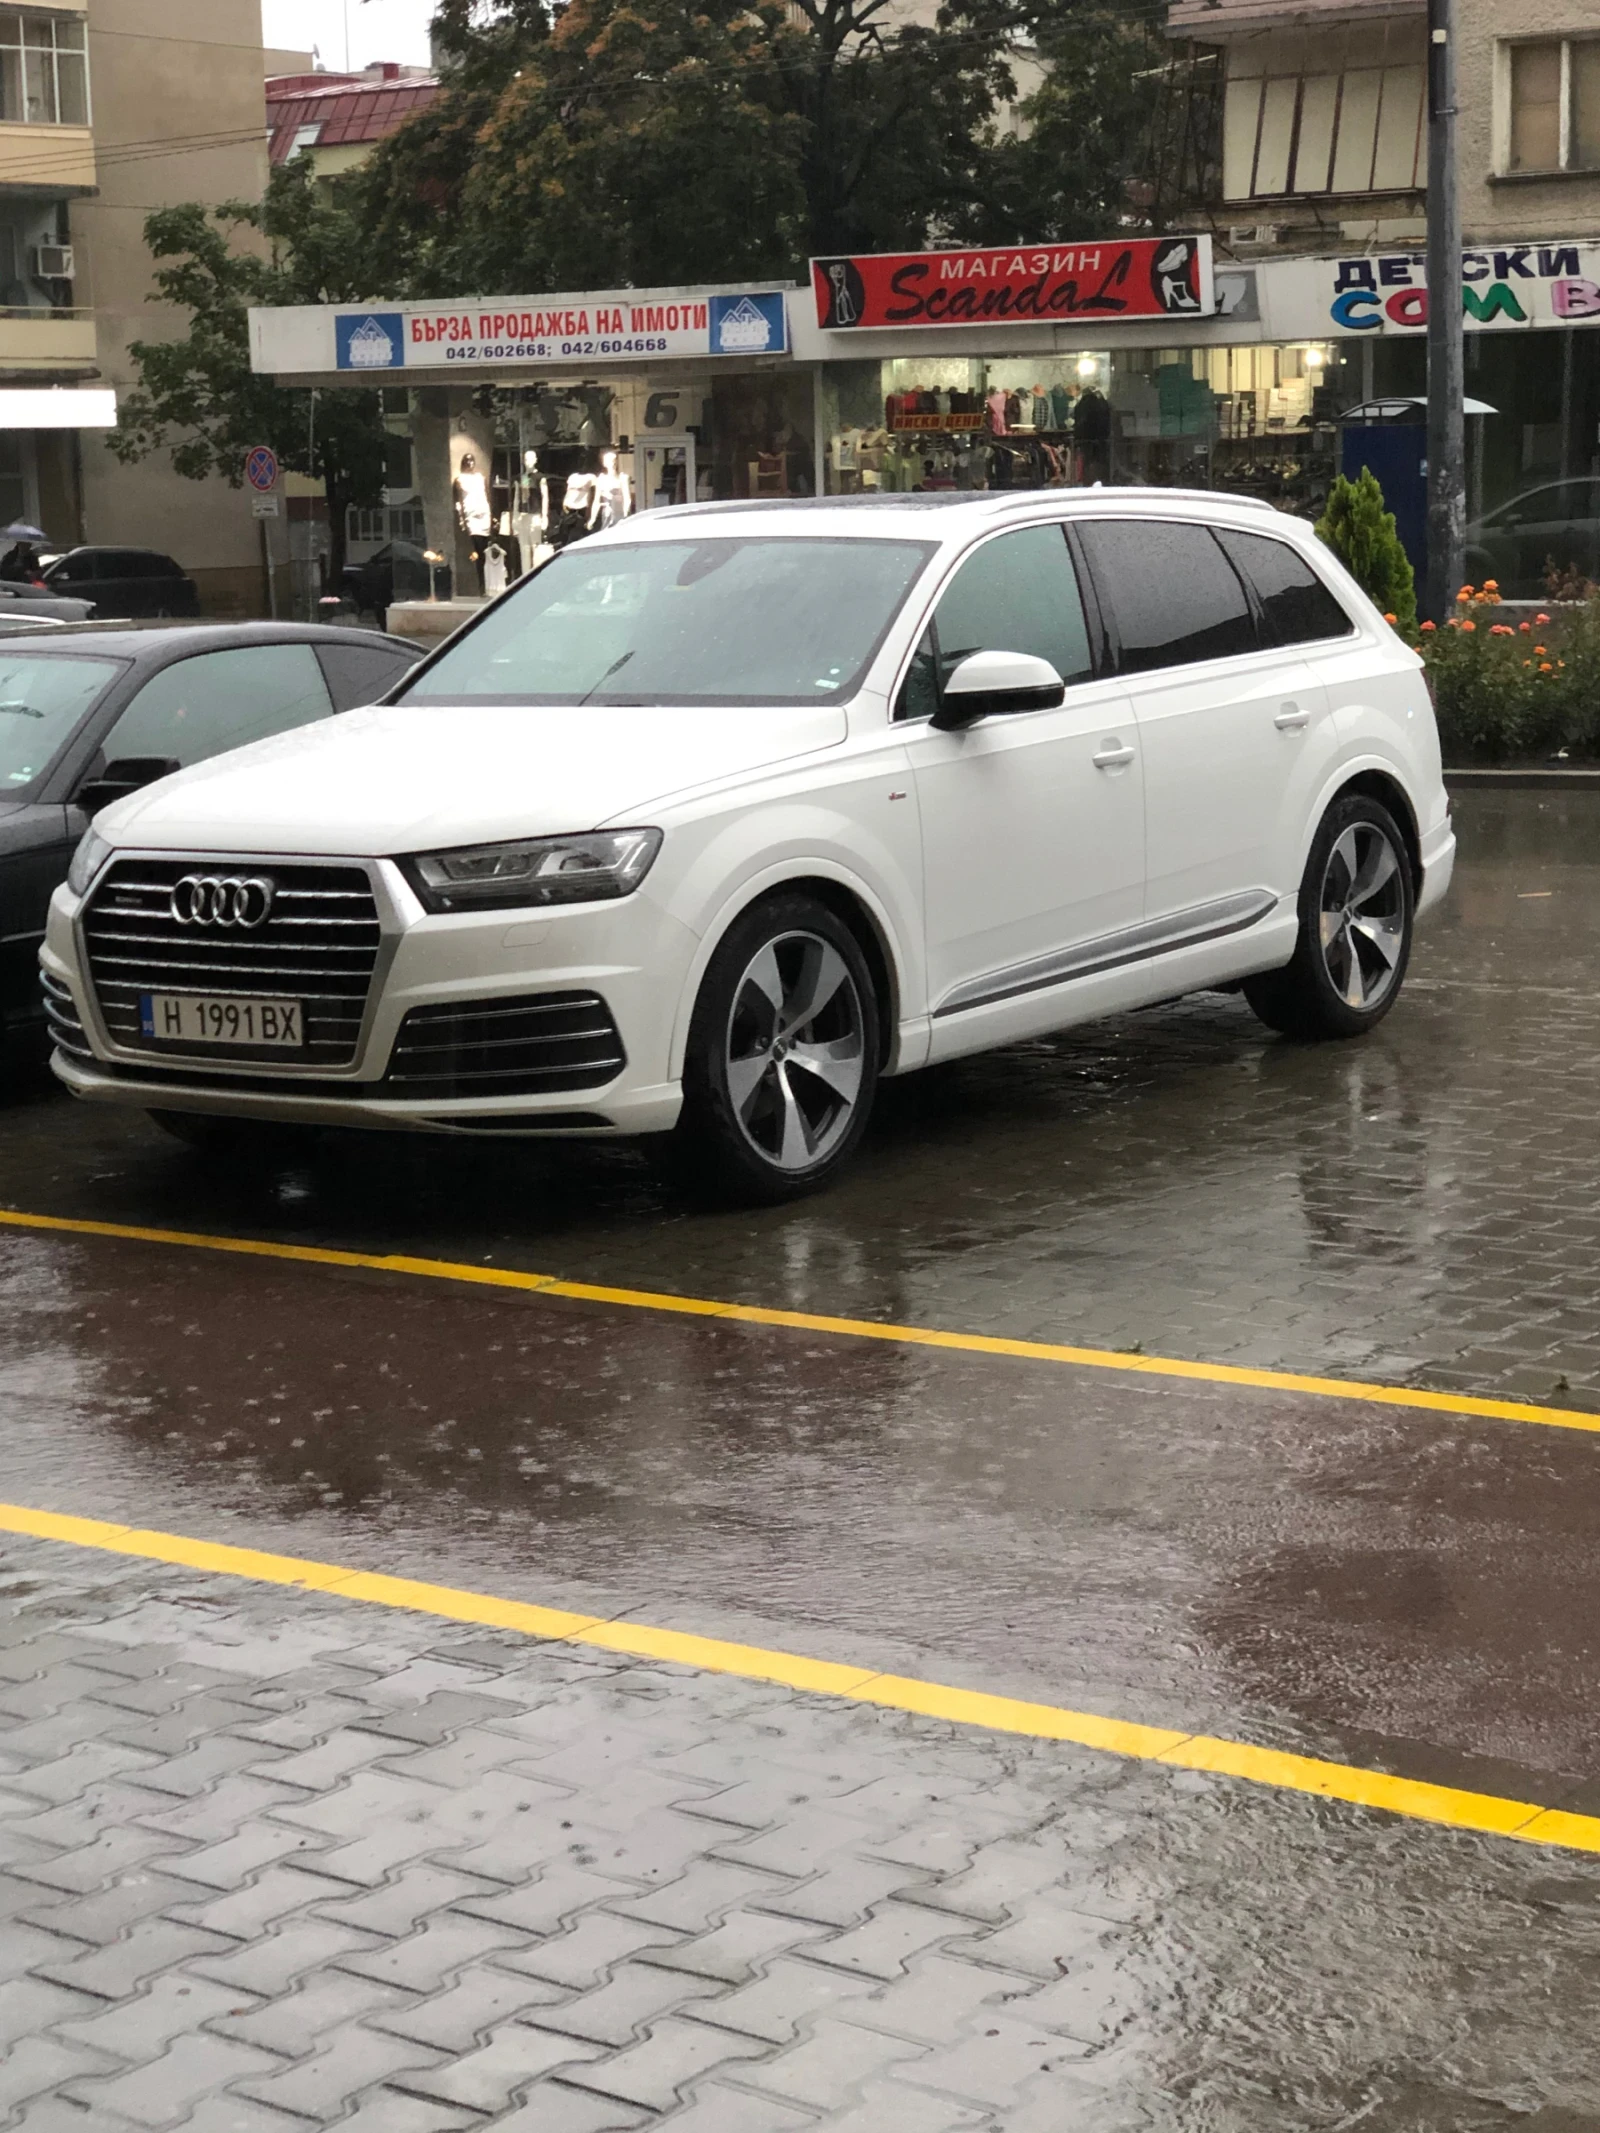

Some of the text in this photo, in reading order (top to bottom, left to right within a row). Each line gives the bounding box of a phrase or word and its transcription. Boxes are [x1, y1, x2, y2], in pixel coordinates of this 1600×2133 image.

[941, 250, 1101, 279] МАГАЗИН
[411, 315, 473, 343] БЪРЗА
[478, 310, 590, 342] ПРОДАЖБА
[596, 308, 624, 335] НА
[631, 304, 708, 333] ИМОТИ
[446, 338, 668, 360] 042/602668; 042/604668
[644, 391, 680, 429] 6
[164, 1000, 181, 1035] H
